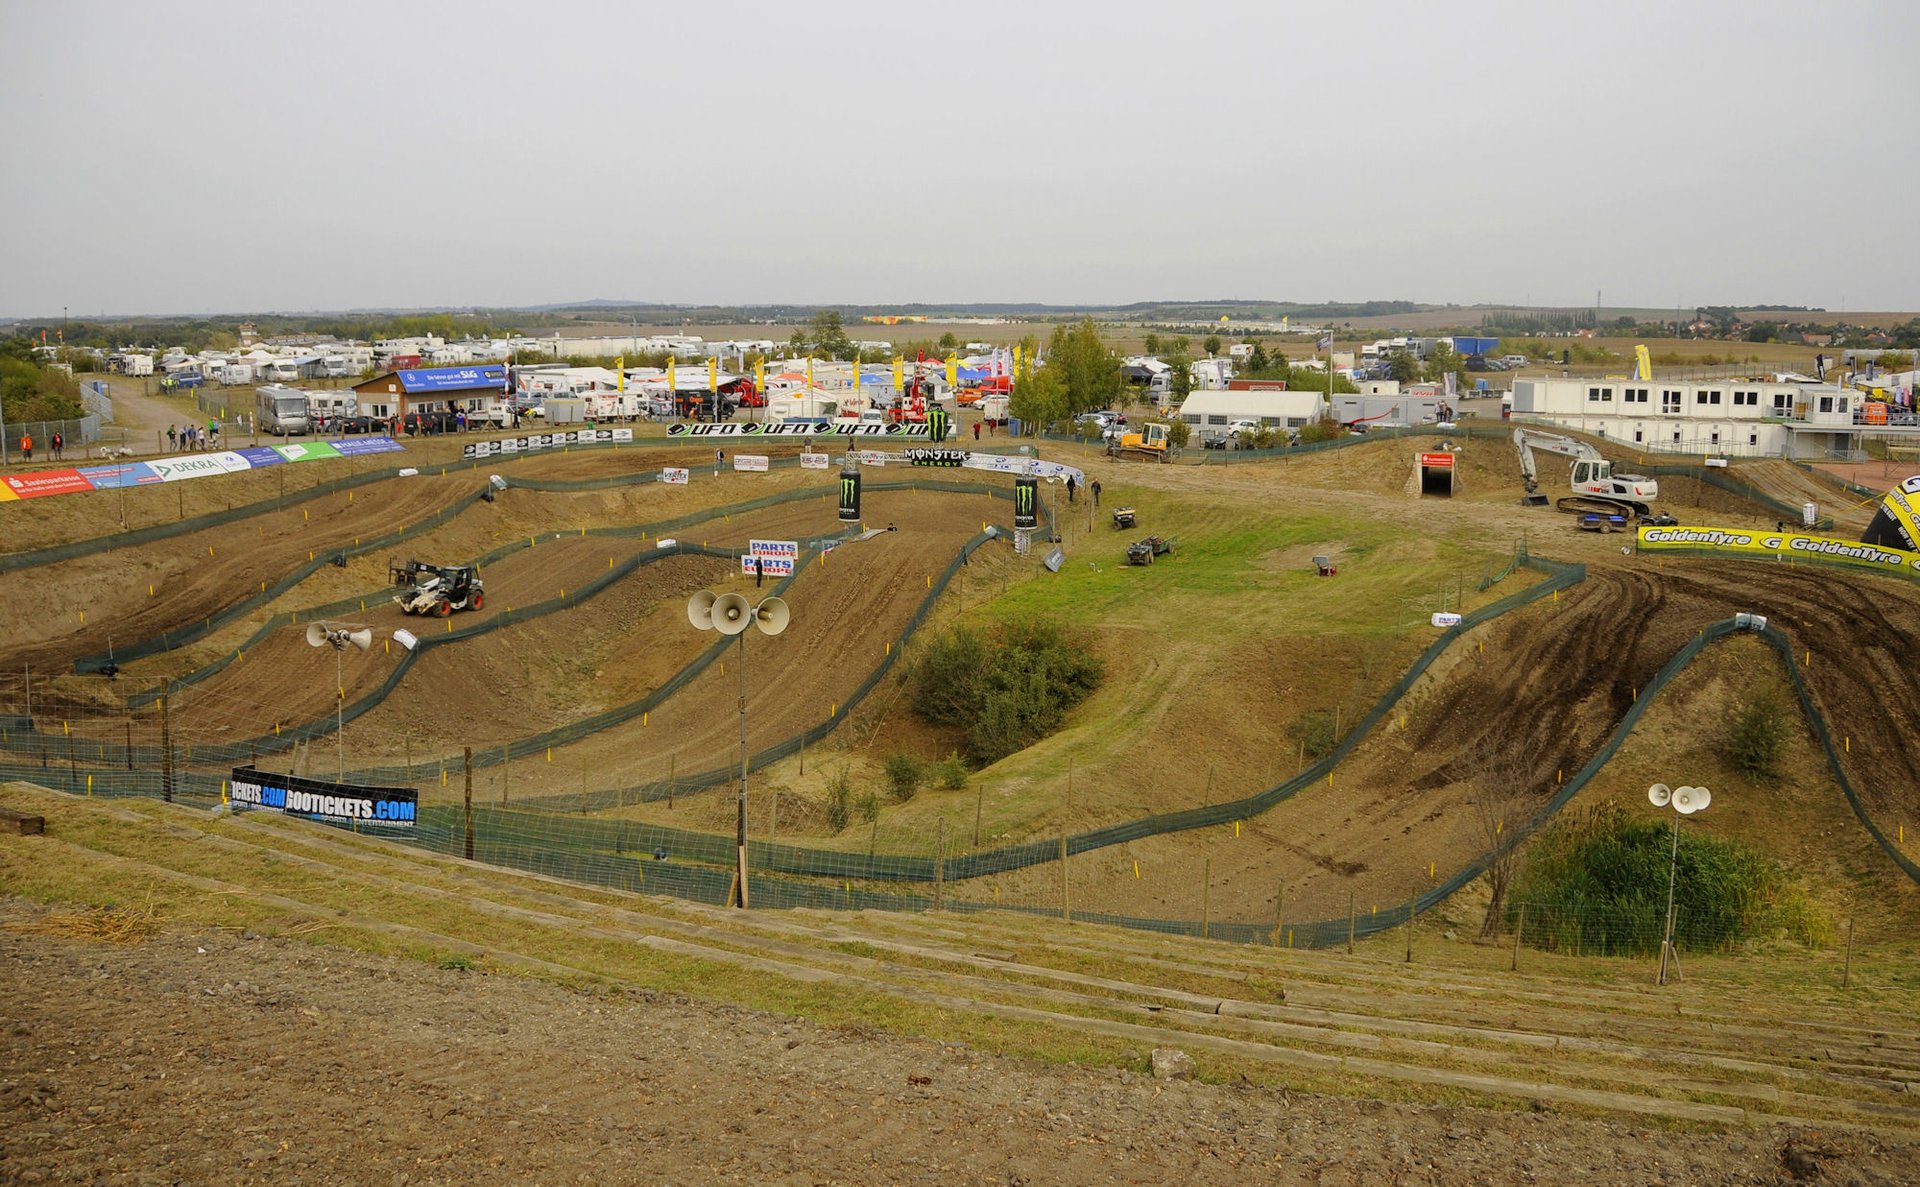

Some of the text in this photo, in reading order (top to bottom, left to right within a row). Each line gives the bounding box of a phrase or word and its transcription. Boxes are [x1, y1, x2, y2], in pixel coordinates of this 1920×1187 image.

[690, 424, 738, 435] UFO
[763, 423, 810, 434] UFO
[836, 423, 882, 434] UFO
[904, 448, 968, 460] MONSTER
[172, 460, 218, 472] DEKRA
[1644, 529, 1752, 546] GoldenTyre
[752, 542, 796, 551] PARTS
[1789, 537, 1902, 565] GoldenTyre
[231, 780, 287, 808] ICKETS.COM
[286, 789, 415, 820] GOOTICKETS.COM
